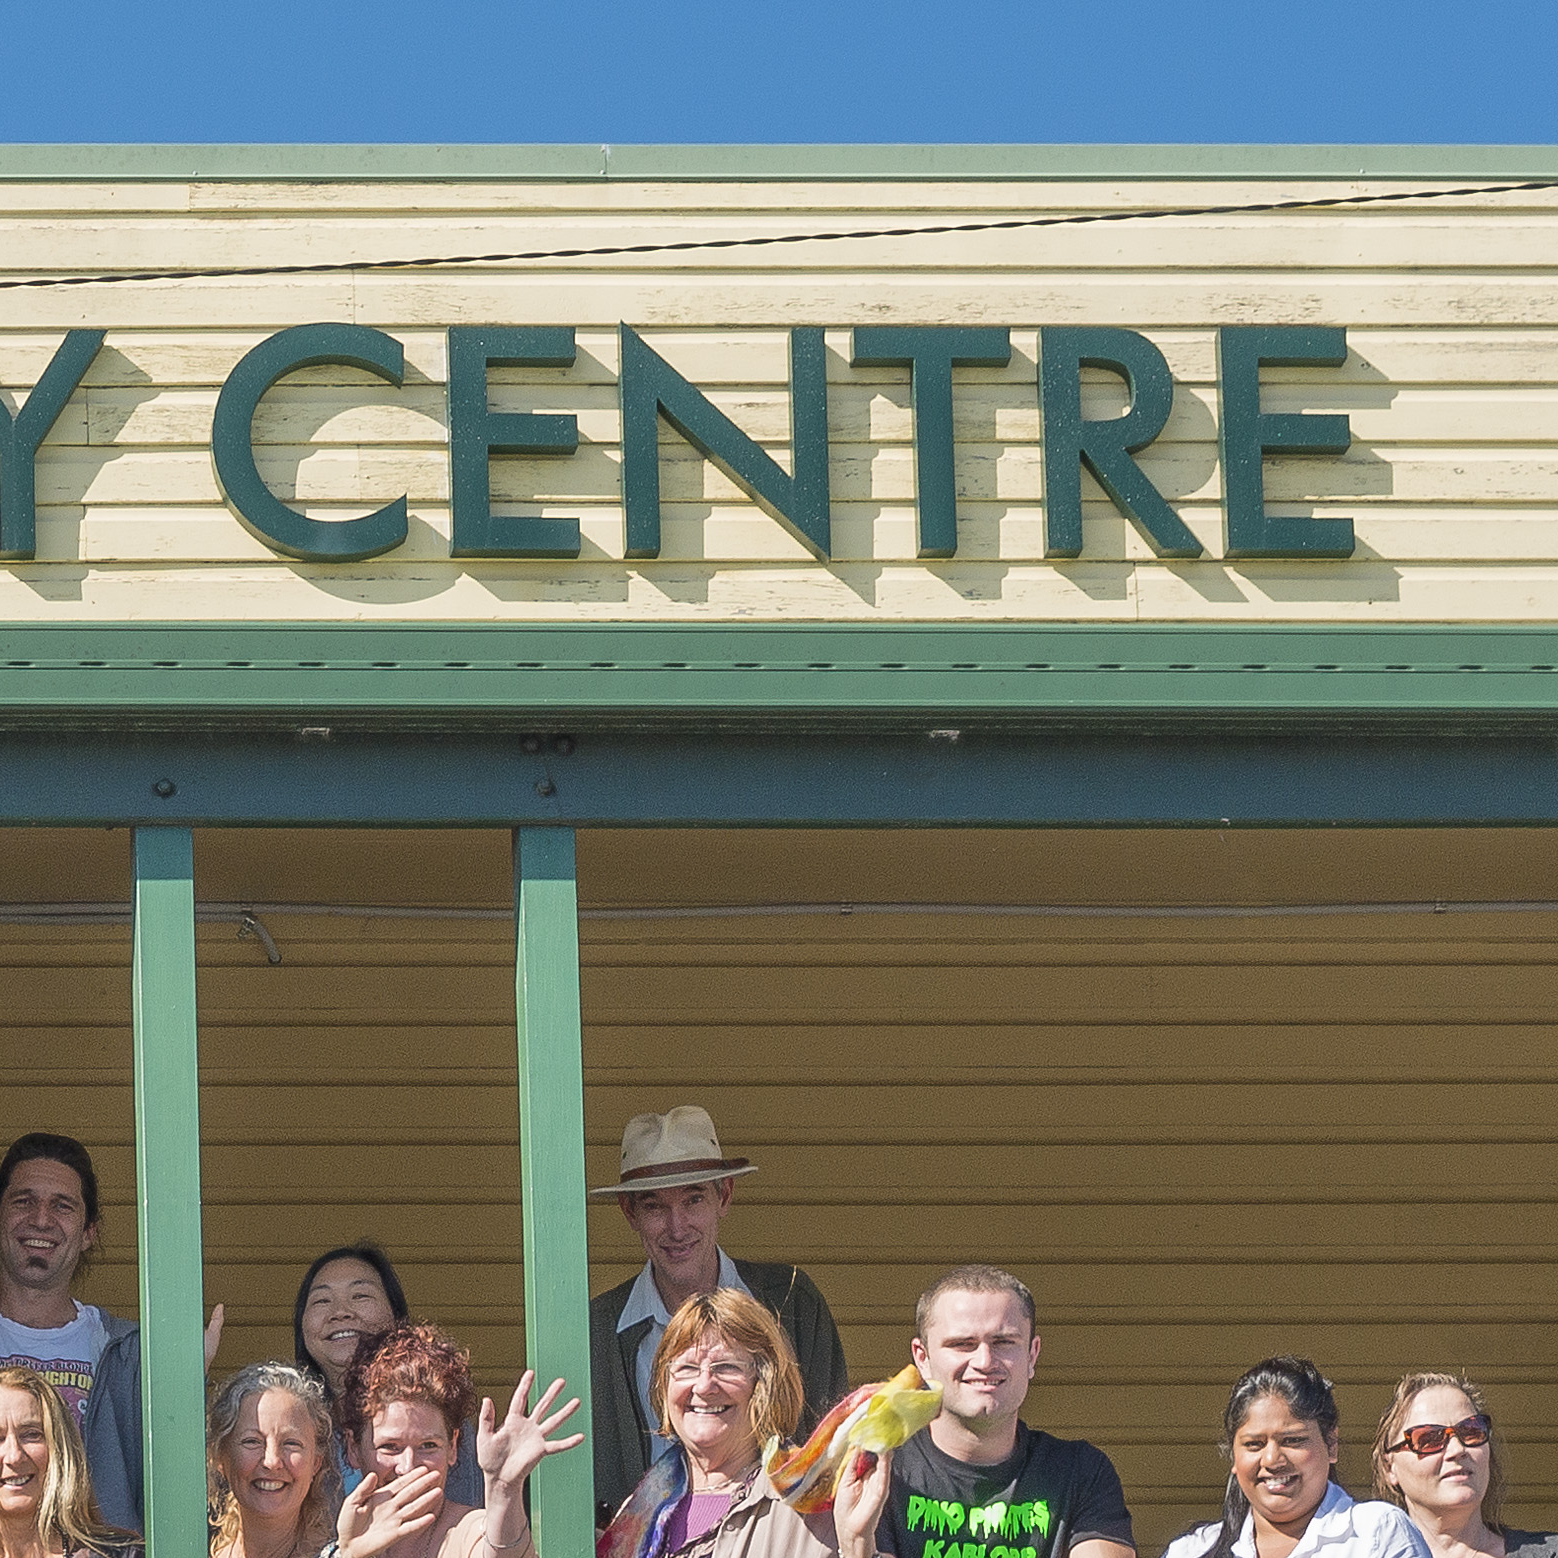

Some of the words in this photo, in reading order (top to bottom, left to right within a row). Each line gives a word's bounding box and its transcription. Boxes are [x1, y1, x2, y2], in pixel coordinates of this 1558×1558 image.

[210, 319, 1357, 564] CENTRE
[907, 1495, 966, 1537] DINO
[969, 1499, 1051, 1542] PIRATES
